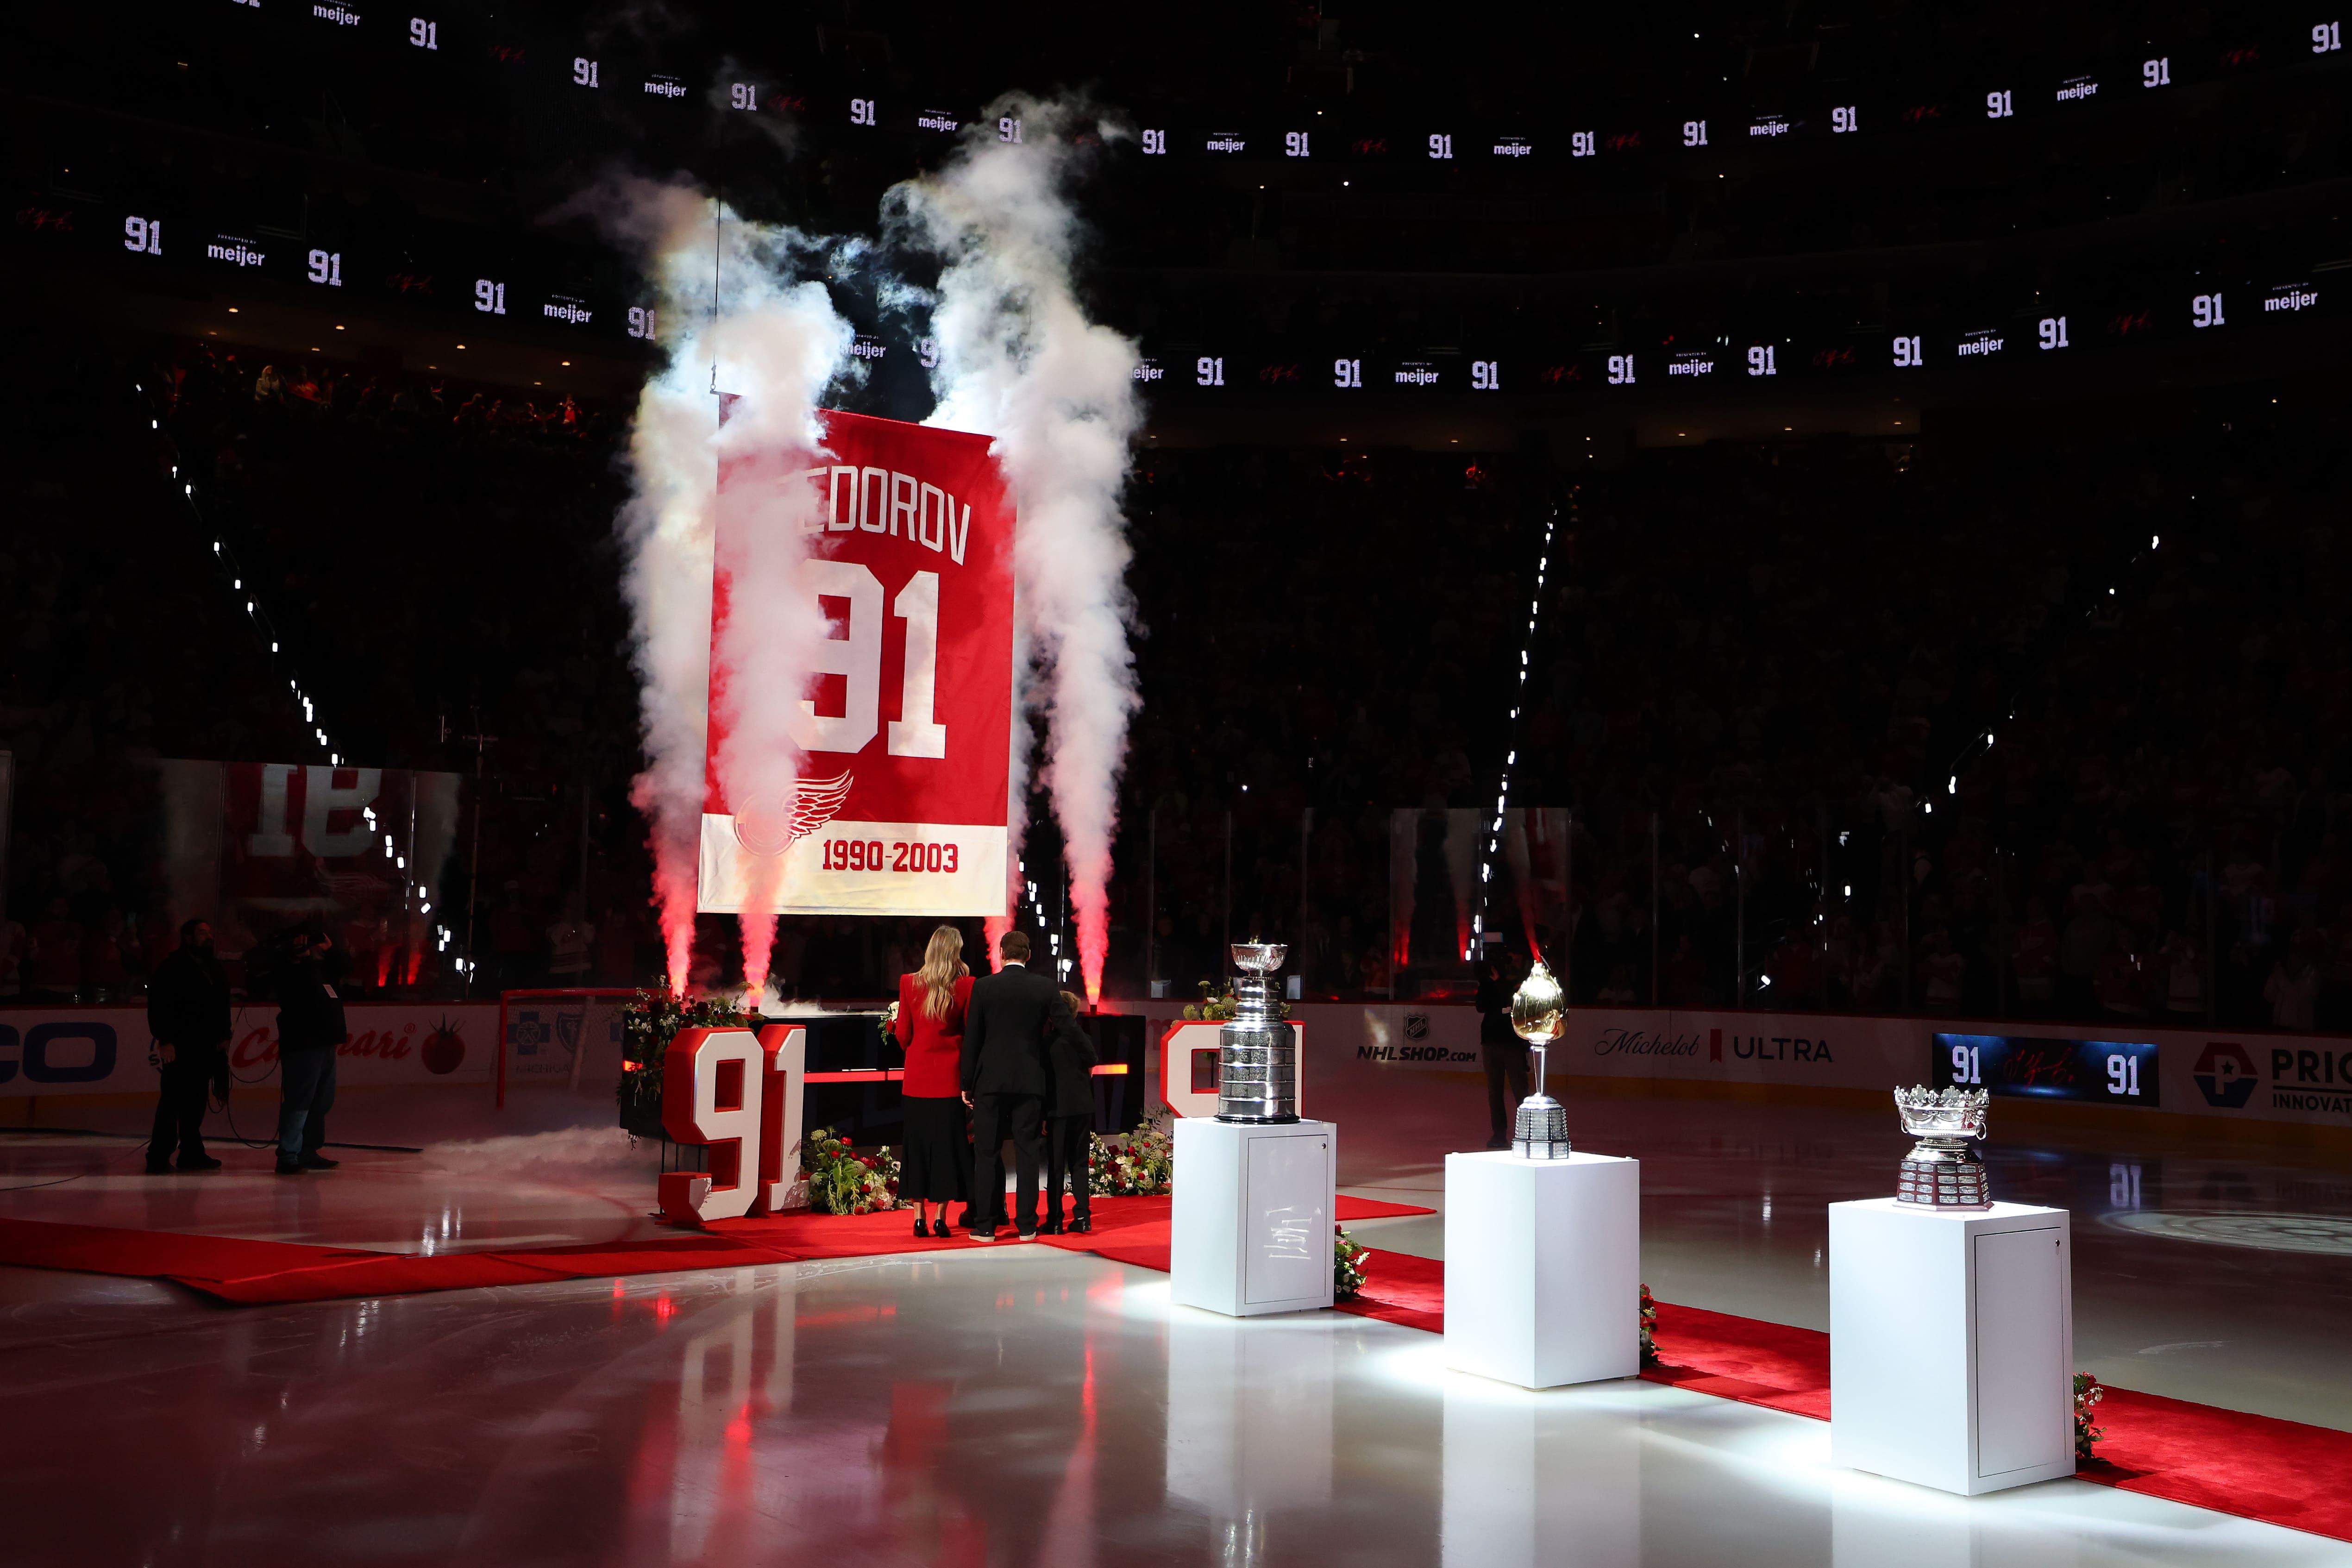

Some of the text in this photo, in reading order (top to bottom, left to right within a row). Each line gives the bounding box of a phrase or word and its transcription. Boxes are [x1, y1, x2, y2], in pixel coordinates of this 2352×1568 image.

[314, 5, 361, 26] meijer
[410, 18, 438, 50] 91
[2313, 22, 2341, 54] 91
[574, 57, 599, 88] 91
[2144, 58, 2170, 88] 91
[645, 82, 687, 99] meijer
[732, 84, 757, 111] 91
[1988, 90, 2013, 119] 91
[2057, 80, 2099, 101] meijer
[851, 99, 876, 126] 91
[918, 117, 958, 132] meijer
[1832, 107, 1858, 133] 91
[1000, 118, 1022, 144] 91
[1142, 130, 1167, 155] 91
[1684, 120, 1708, 147] 91
[1750, 121, 1790, 137] meijer
[1207, 138, 1246, 154] meijer
[1286, 132, 1310, 157] 91
[1430, 134, 1453, 159] 91
[1494, 143, 1532, 158] meijer
[1573, 132, 1596, 157] 91
[125, 216, 162, 256] 91
[208, 242, 265, 267] meijer
[308, 249, 342, 287] 91
[475, 280, 506, 315] 91
[2193, 294, 2225, 328] 91
[2265, 290, 2318, 312] meijer
[544, 302, 592, 324] meijer
[627, 307, 656, 340] 91
[1958, 336, 2004, 356] meijer
[2039, 317, 2069, 350] 91
[920, 339, 940, 369] 9
[1749, 346, 1777, 376] 91
[1894, 336, 1923, 367] 91
[1133, 365, 1164, 382] eijer
[1198, 357, 1225, 386] 91
[1335, 359, 1362, 388] 91
[1396, 369, 1439, 386] meijer
[1473, 361, 1499, 390] 91
[1608, 355, 1636, 385] 91
[1669, 359, 1714, 377] meijer
[783, 465, 971, 566] EDOROV
[787, 558, 947, 759] 91
[823, 839, 958, 873] 1990-2003
[232, 1027, 412, 1068] Caari
[1594, 1029, 1832, 1063] Michelob ULTRA
[1952, 1045, 1982, 1084] 91
[2107, 1054, 2140, 1096] 91
[2273, 1094, 2352, 1112] INNOVAT
[659, 1024, 810, 1223] 91
